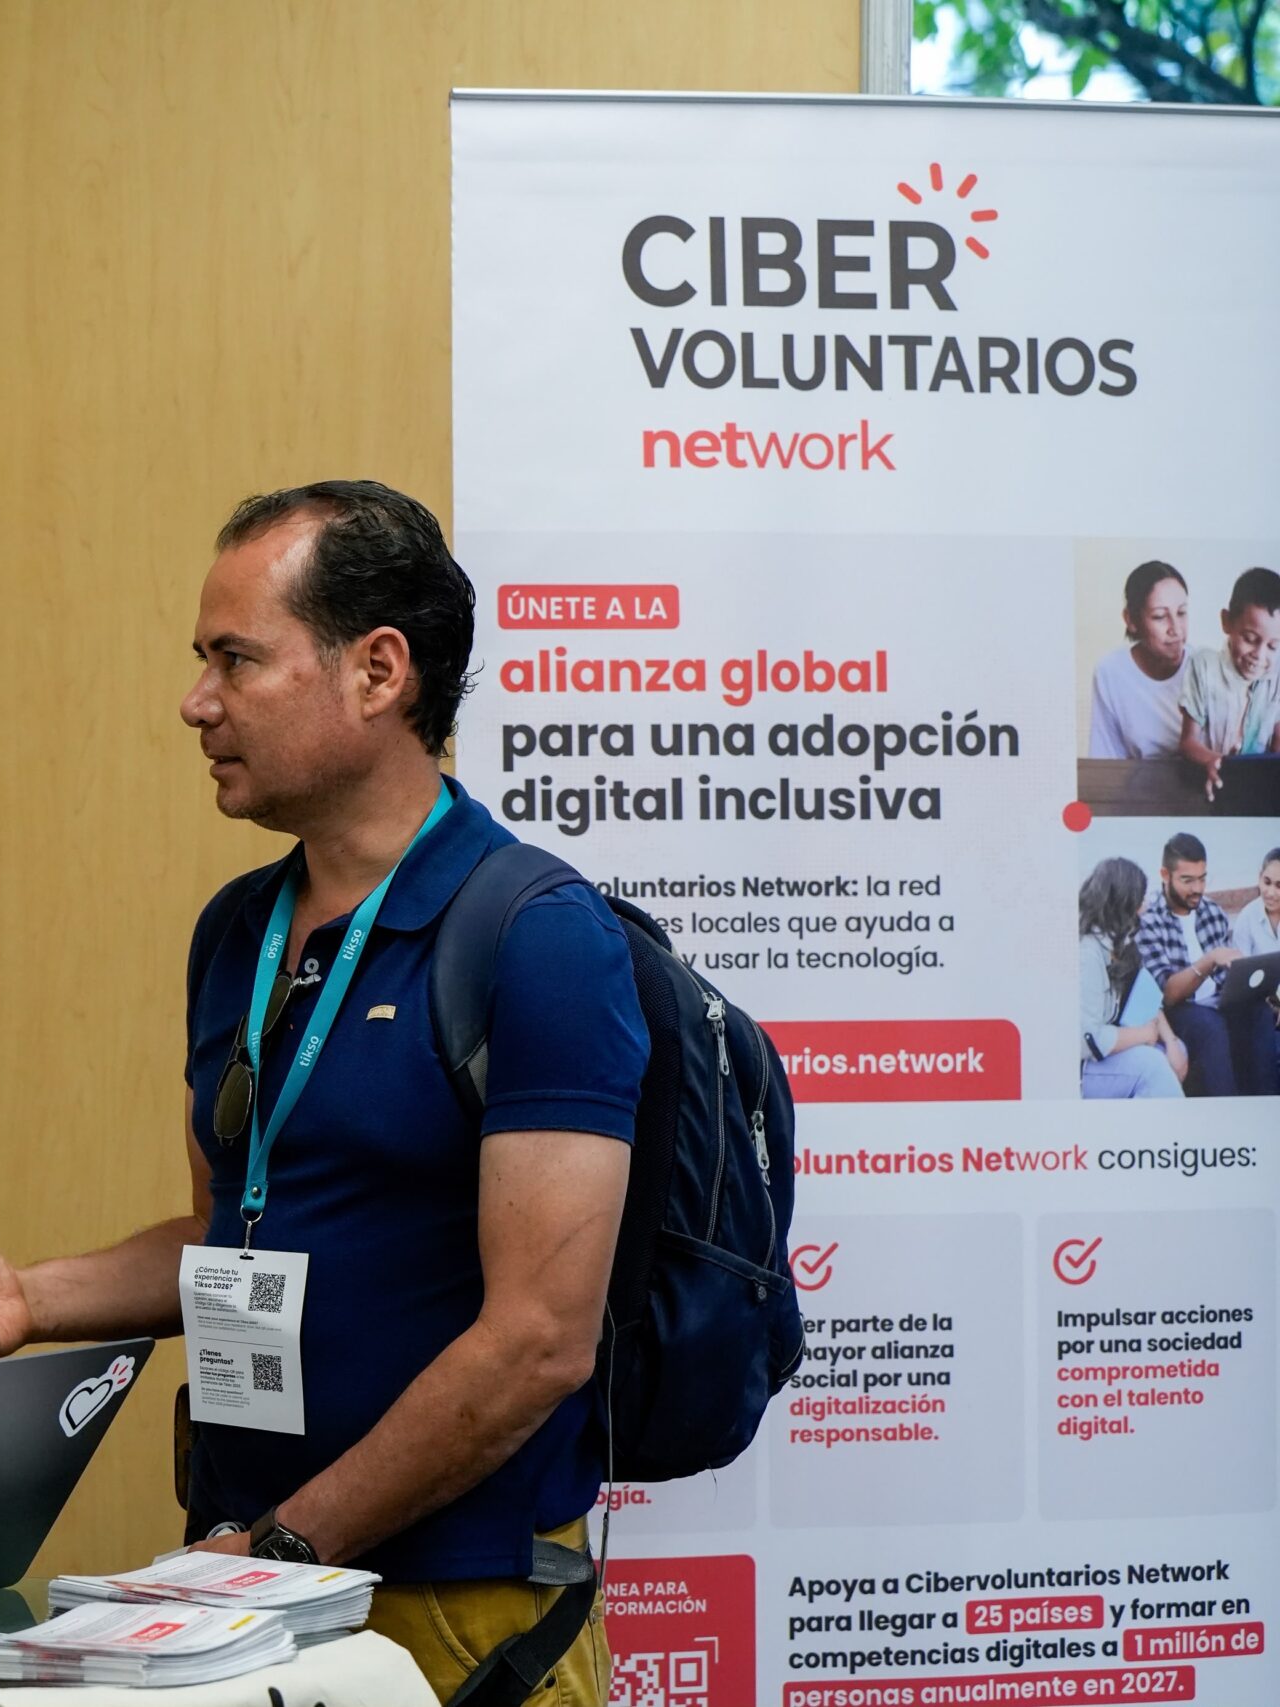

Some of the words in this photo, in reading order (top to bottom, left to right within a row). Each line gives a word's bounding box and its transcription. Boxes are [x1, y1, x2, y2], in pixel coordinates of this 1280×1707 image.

[622, 215, 958, 311] CIBER
[630, 328, 1137, 396] VOLUNTARIOS
[643, 420, 895, 470] network
[507, 591, 596, 620] ÚNETE
[605, 597, 625, 619] A
[634, 597, 667, 620] LA
[500, 647, 706, 692] alianza
[721, 650, 887, 707] global
[503, 724, 634, 772] para
[651, 724, 754, 756] una
[768, 710, 1019, 771] adopción
[501, 775, 683, 836] digital
[699, 775, 940, 820] inclusiva
[593, 874, 736, 898] oluntarios
[743, 876, 858, 897] Network:
[867, 876, 889, 896] la
[899, 875, 940, 896] red
[692, 912, 780, 933] locales
[788, 917, 837, 940] que
[845, 911, 930, 939] ayuda
[939, 916, 954, 931] a
[268, 933, 282, 959] tikso
[342, 929, 362, 960] tikso
[705, 953, 760, 969] usar
[768, 948, 788, 969] la
[797, 946, 944, 975] tecnología.
[299, 1035, 319, 1067] tikso
[794, 1145, 953, 1174] oluntarios
[962, 1145, 1087, 1172] Network
[1098, 1142, 1256, 1177] consigues:
[194, 1274, 232, 1283] experiencia
[195, 1267, 218, 1275] ¿Cómo
[803, 1318, 826, 1333] er
[831, 1316, 894, 1339] parte
[899, 1314, 927, 1331] de
[933, 1313, 952, 1331] la
[1058, 1308, 1156, 1332] Impulsar
[1161, 1305, 1253, 1324] acciones
[200, 1349, 221, 1357] ¿Tienes
[871, 1340, 954, 1359] alianza
[1058, 1340, 1094, 1360] por
[1100, 1339, 1141, 1353] una
[1148, 1331, 1242, 1351] sociedad
[200, 1356, 233, 1366] preguntas?
[1057, 1359, 1220, 1386] comprometida
[790, 1369, 858, 1388] social
[864, 1373, 902, 1393] por
[908, 1372, 950, 1386] una
[790, 1394, 945, 1422] digitalización
[1057, 1392, 1098, 1408] con
[1103, 1387, 1123, 1406] el
[1127, 1388, 1204, 1406] talento
[790, 1423, 938, 1448] responsable.
[1057, 1416, 1135, 1441] digital.
[603, 1583, 639, 1597] NEA
[644, 1581, 688, 1595] PARA
[789, 1577, 875, 1603] Apoya
[882, 1578, 898, 1594] a
[906, 1564, 1120, 1593] Cibervoluntarios
[1128, 1560, 1229, 1584] Network
[605, 1597, 707, 1615] FORMACIÓN
[790, 1616, 852, 1640] para
[860, 1610, 936, 1637] llegar
[942, 1612, 957, 1628] a
[975, 1605, 1003, 1627] 25
[1009, 1600, 1094, 1634] países
[1110, 1605, 1125, 1628] y
[1131, 1598, 1216, 1620] formar
[1222, 1599, 1249, 1615] en
[789, 1647, 979, 1674] competencias
[986, 1638, 1095, 1668] digitales
[1102, 1641, 1117, 1656] a
[1135, 1635, 1142, 1655] 1
[1150, 1630, 1225, 1655] millón
[1231, 1629, 1259, 1650] de
[789, 1687, 915, 1707] personas
[920, 1677, 1077, 1704] anualmente
[1083, 1679, 1115, 1695] en
[1122, 1671, 1183, 1694] 2027.
